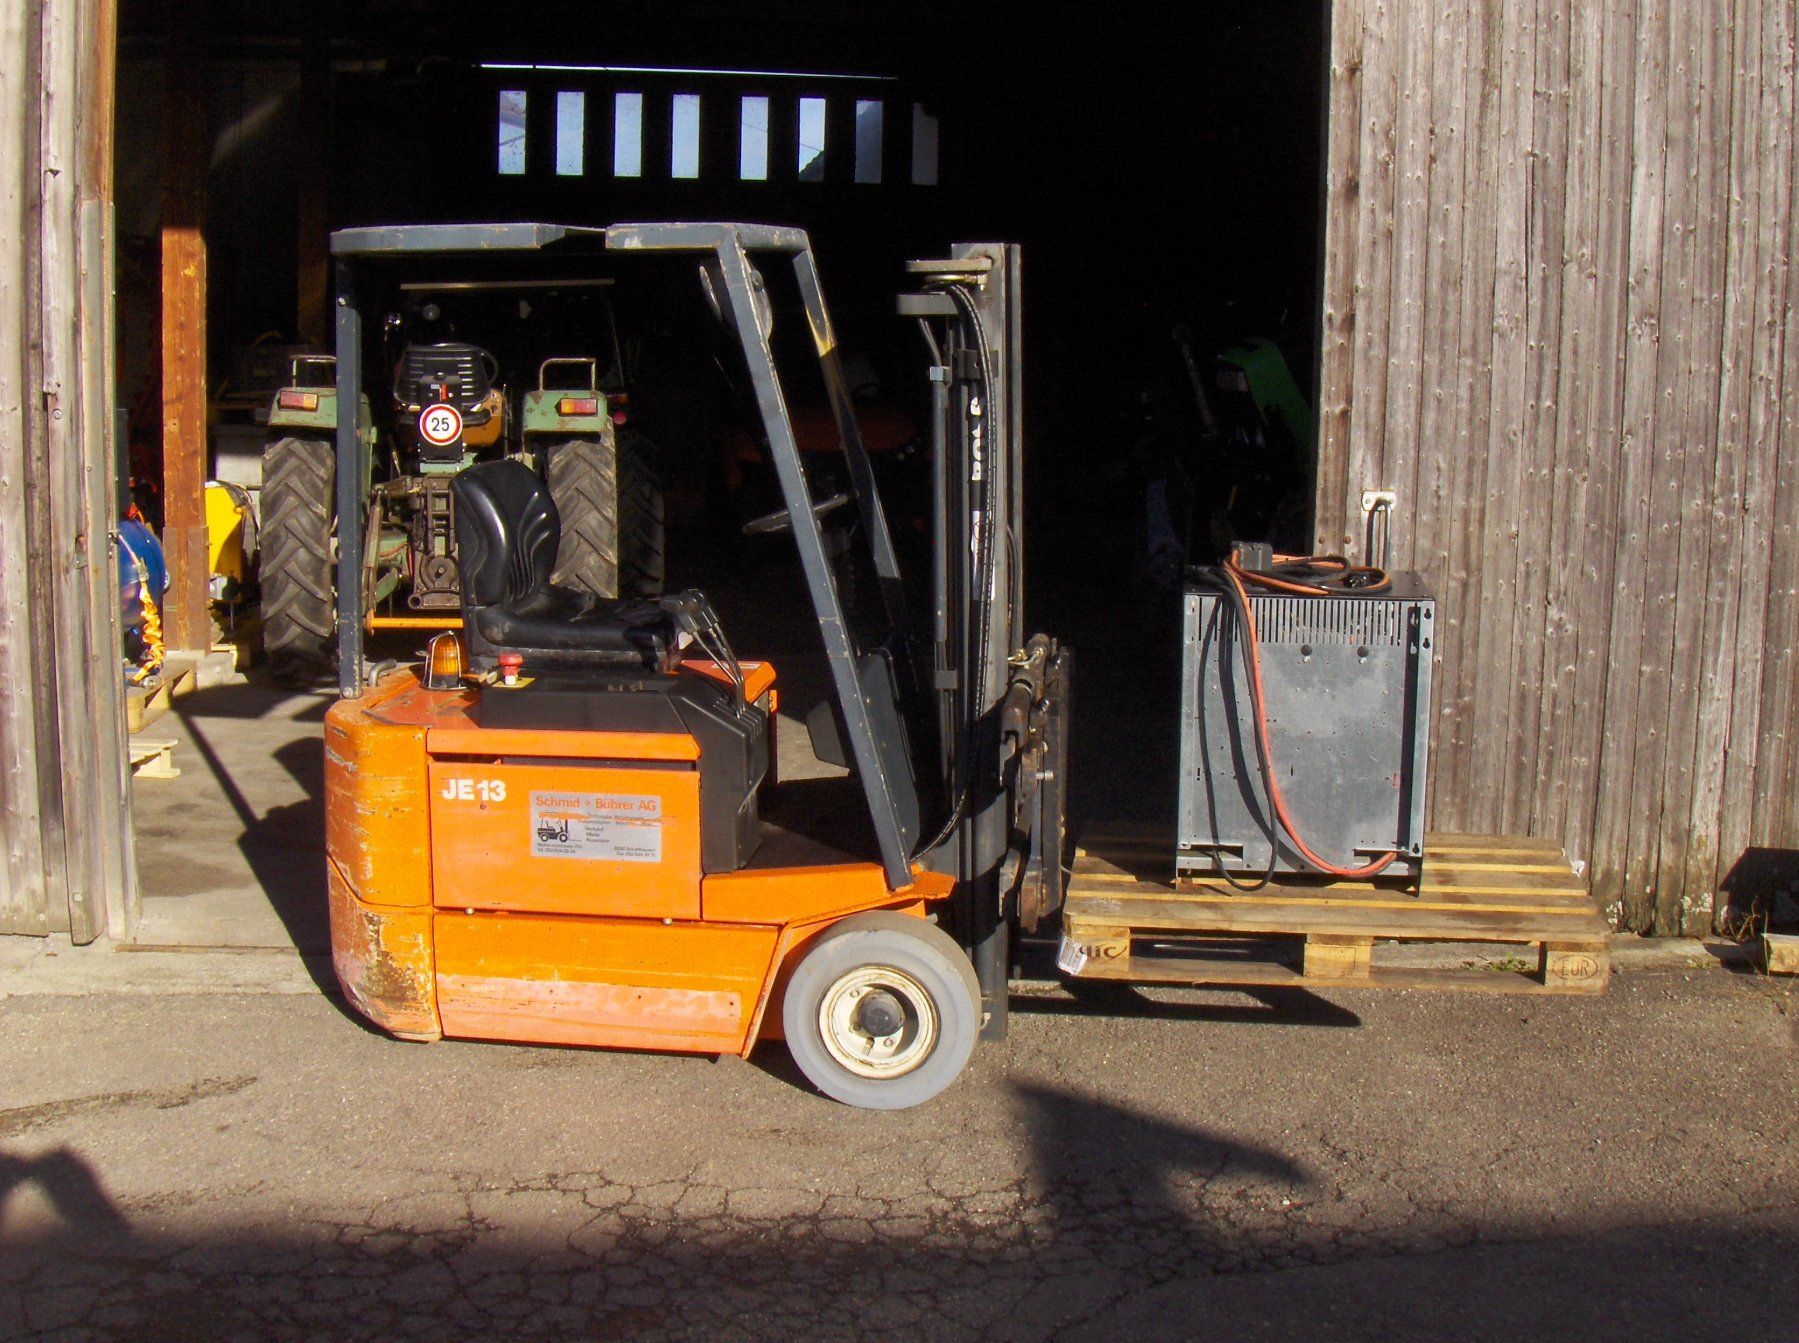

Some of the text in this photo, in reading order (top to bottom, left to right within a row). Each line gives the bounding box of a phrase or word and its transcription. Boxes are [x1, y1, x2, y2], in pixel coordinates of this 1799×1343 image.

[431, 417, 450, 432] 25
[536, 796, 581, 809] Schmid
[595, 798, 634, 810] Bührer
[638, 800, 656, 811] AG
[1561, 959, 1589, 976] EUR
